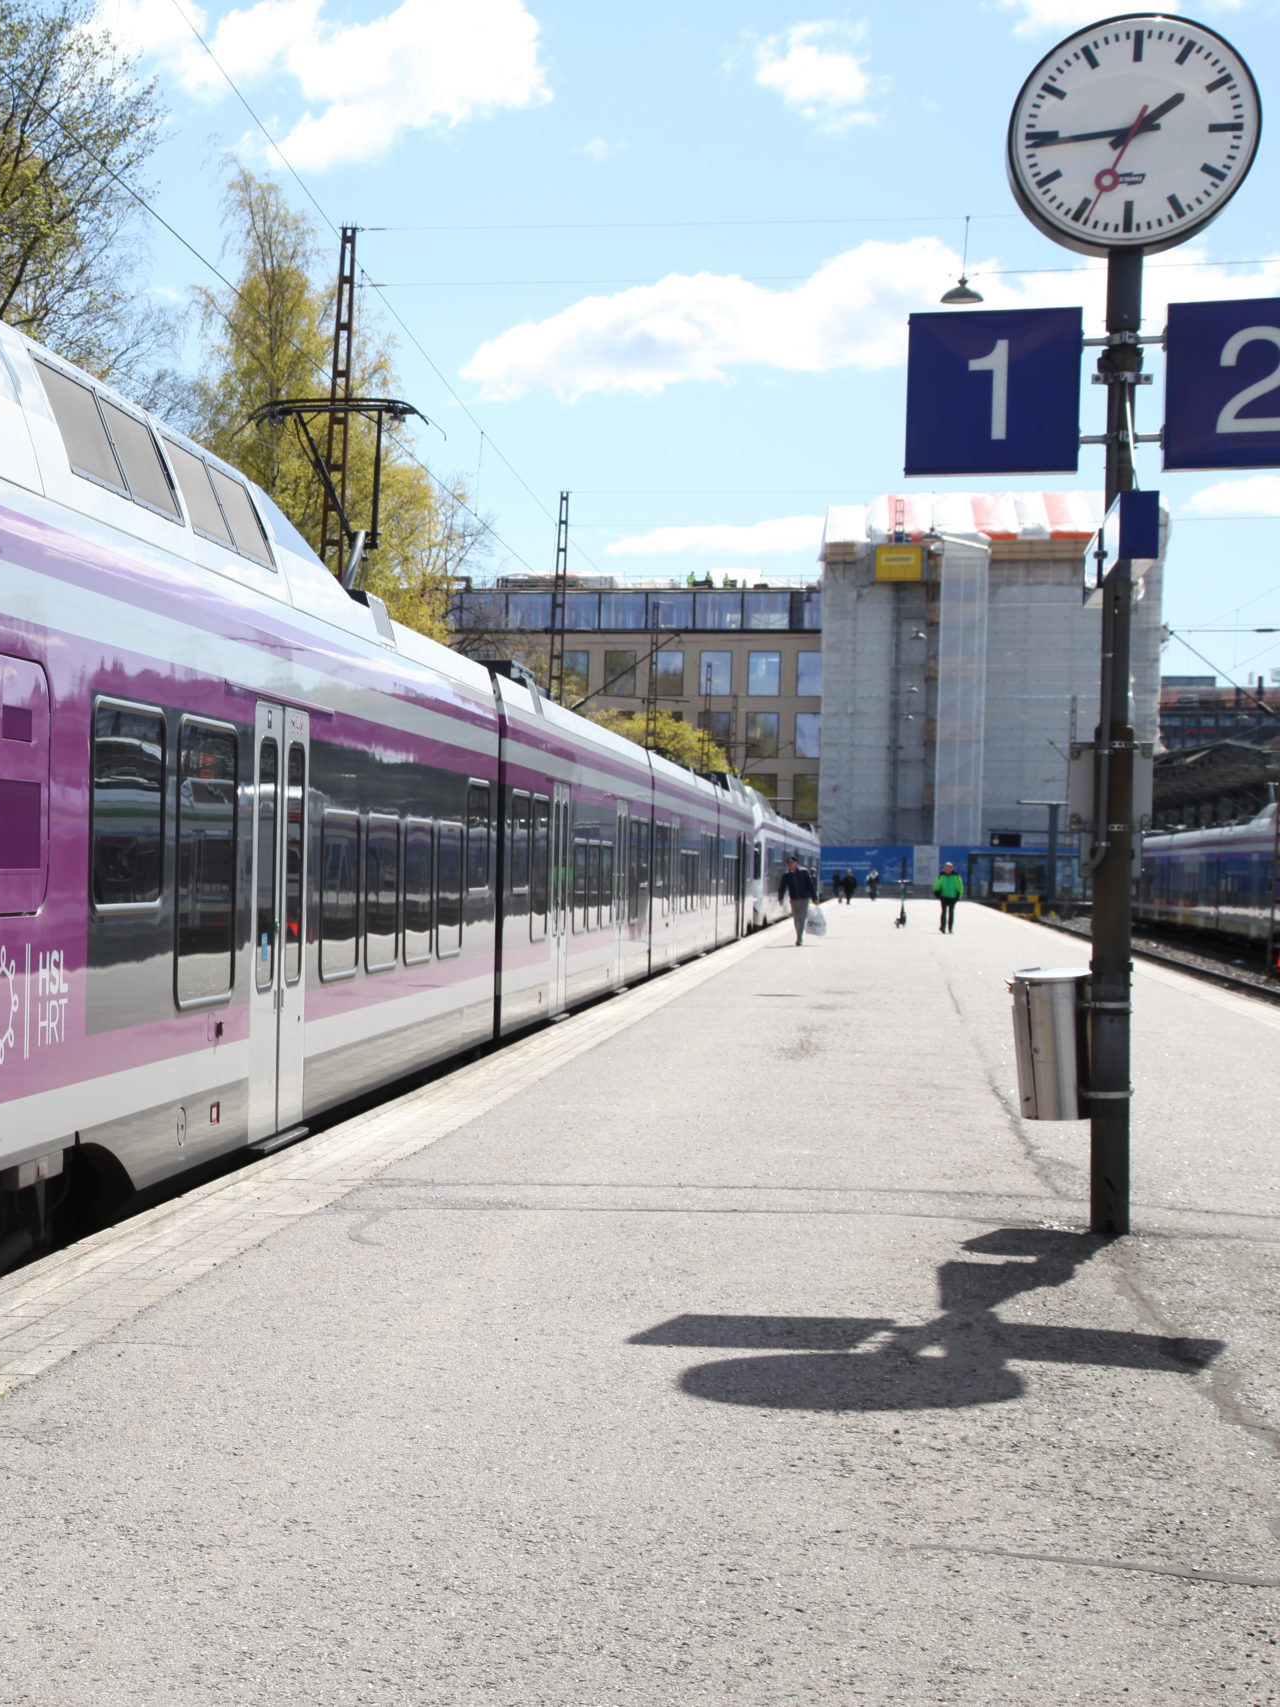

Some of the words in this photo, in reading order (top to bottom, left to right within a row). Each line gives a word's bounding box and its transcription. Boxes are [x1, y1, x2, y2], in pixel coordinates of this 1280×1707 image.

[968, 339, 1009, 440] 1
[1215, 326, 1280, 434] 2
[39, 949, 68, 996] HSL
[38, 998, 68, 1048] HRT
